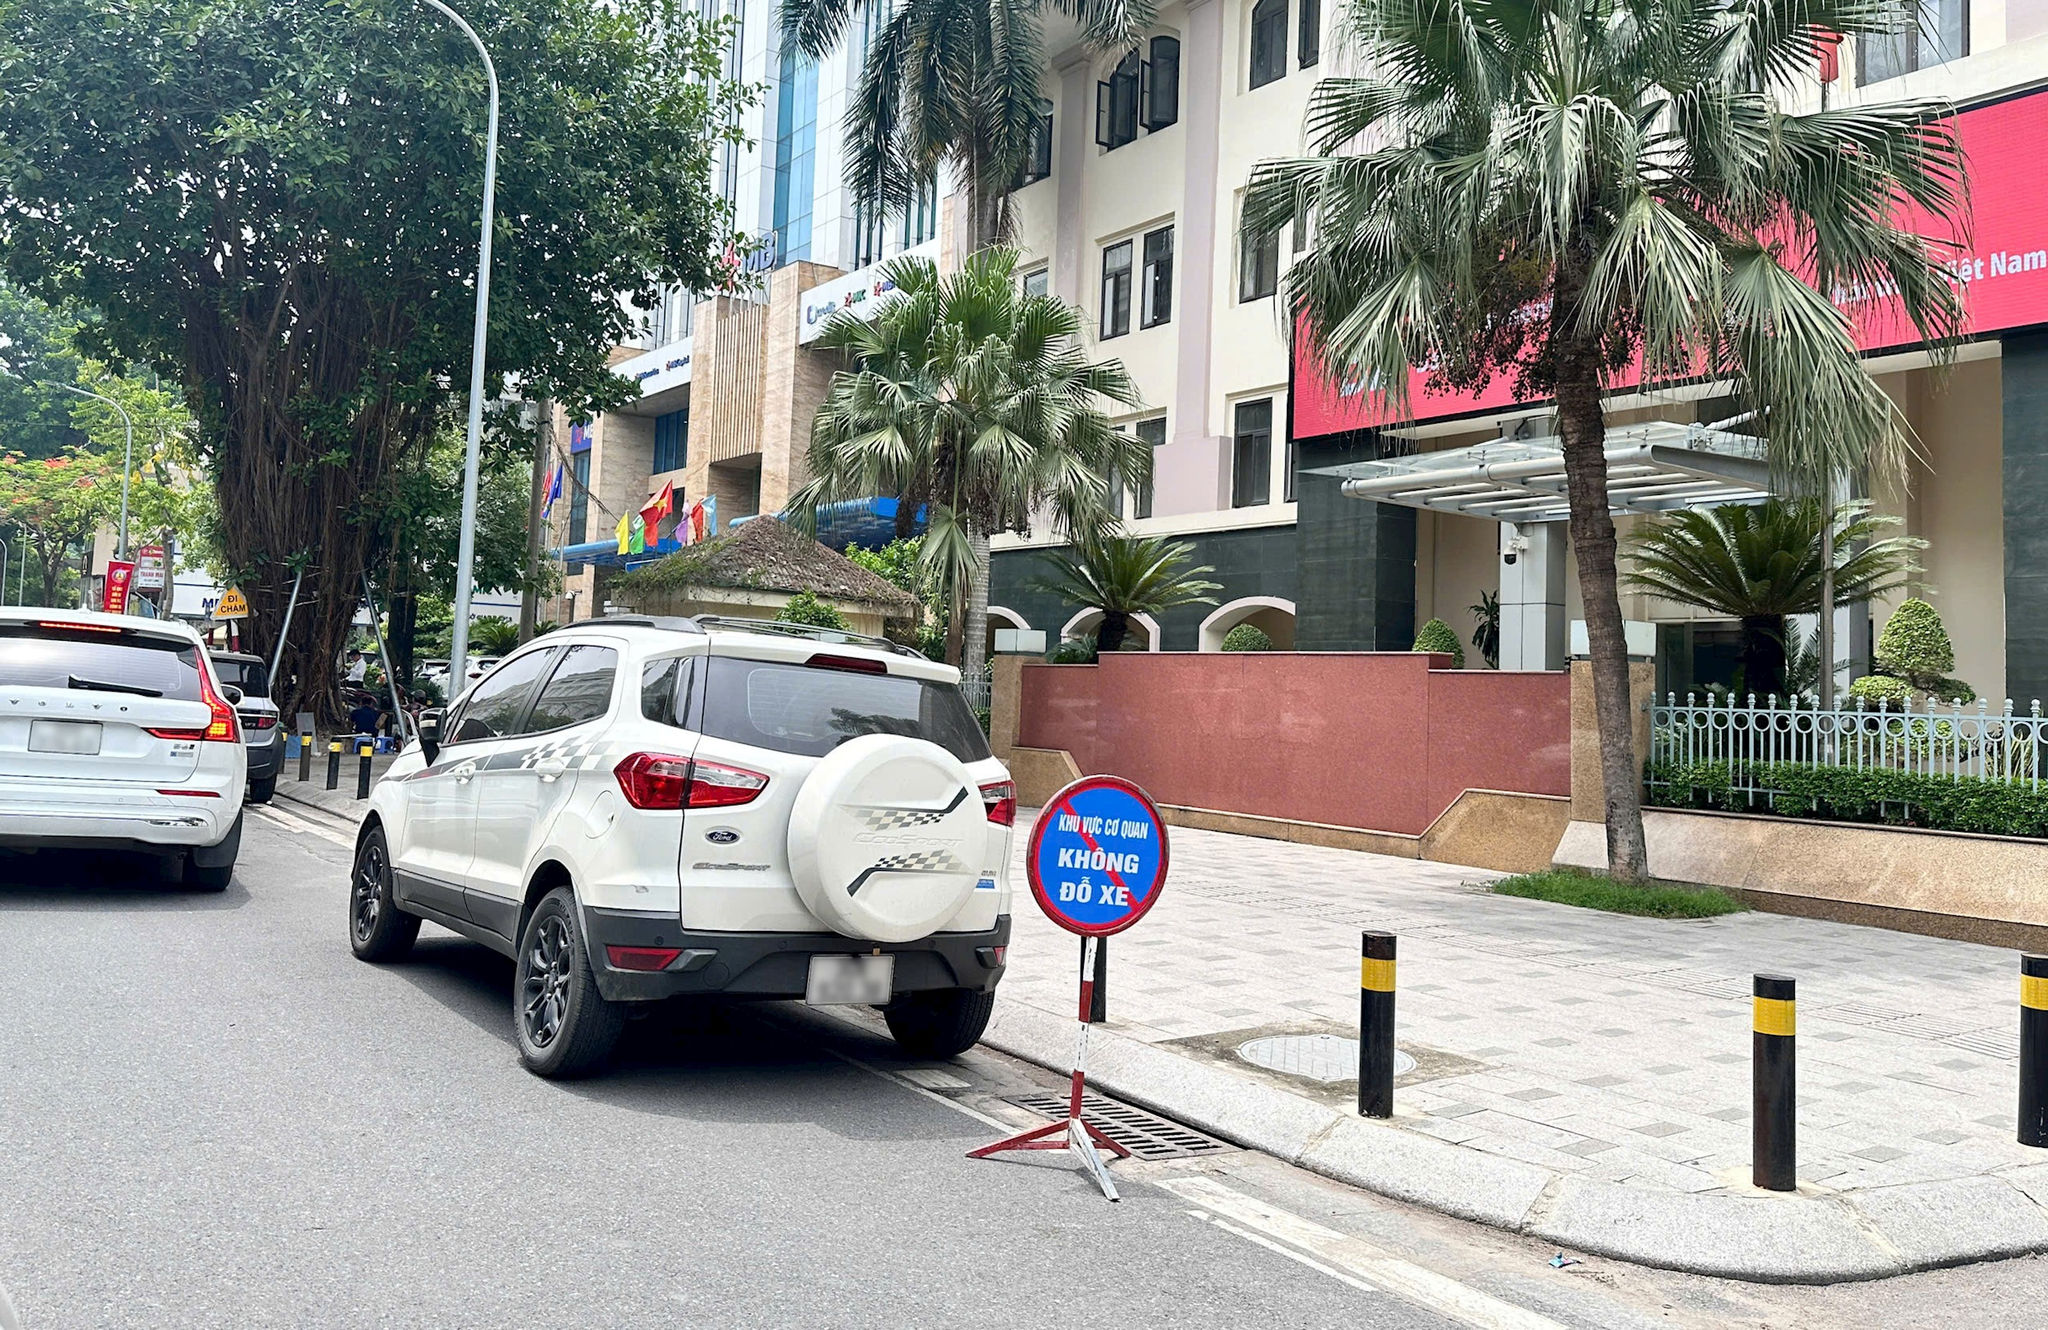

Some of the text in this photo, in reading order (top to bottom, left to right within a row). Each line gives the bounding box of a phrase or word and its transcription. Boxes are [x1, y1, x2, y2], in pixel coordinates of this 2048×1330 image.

[1990, 249, 2047, 278] Nam
[712, 831, 732, 840] Ford
[1058, 814, 1149, 839] KHU VỰC CƠ QUAN
[1057, 846, 1139, 874] KHÔNG
[1059, 876, 1130, 906] ĐỖ XE
